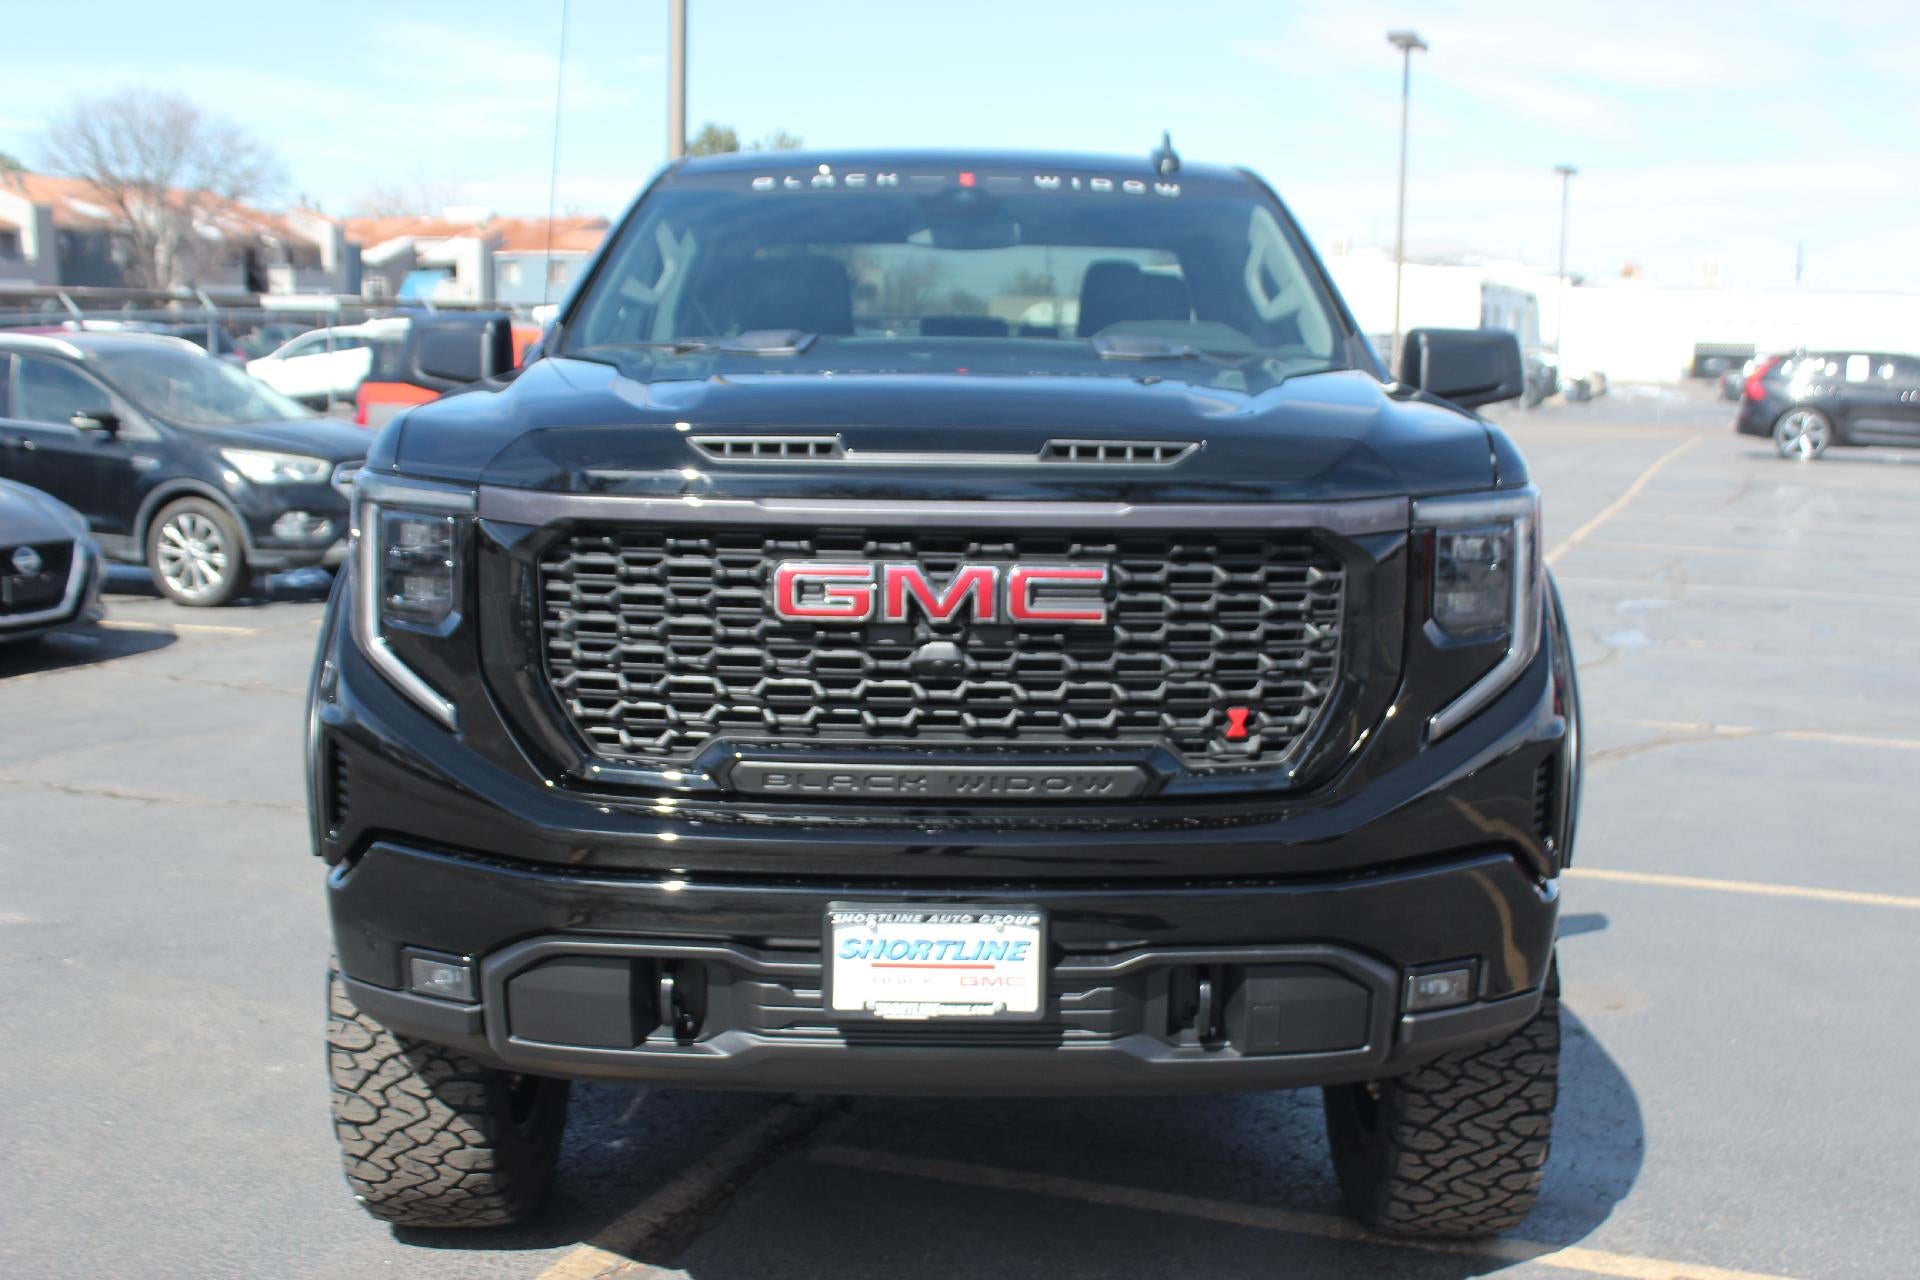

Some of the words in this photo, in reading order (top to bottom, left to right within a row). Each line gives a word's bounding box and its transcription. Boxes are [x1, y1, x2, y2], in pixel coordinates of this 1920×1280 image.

[752, 173, 898, 191] BLACK
[1034, 176, 1181, 197] WIDOW
[774, 562, 1107, 624] GMC
[762, 774, 927, 791] BLACK
[949, 776, 1113, 793] WIDOW
[929, 914, 973, 923] AUTO
[838, 939, 1031, 961] SHORTLINE
[960, 976, 1024, 987] GMC
